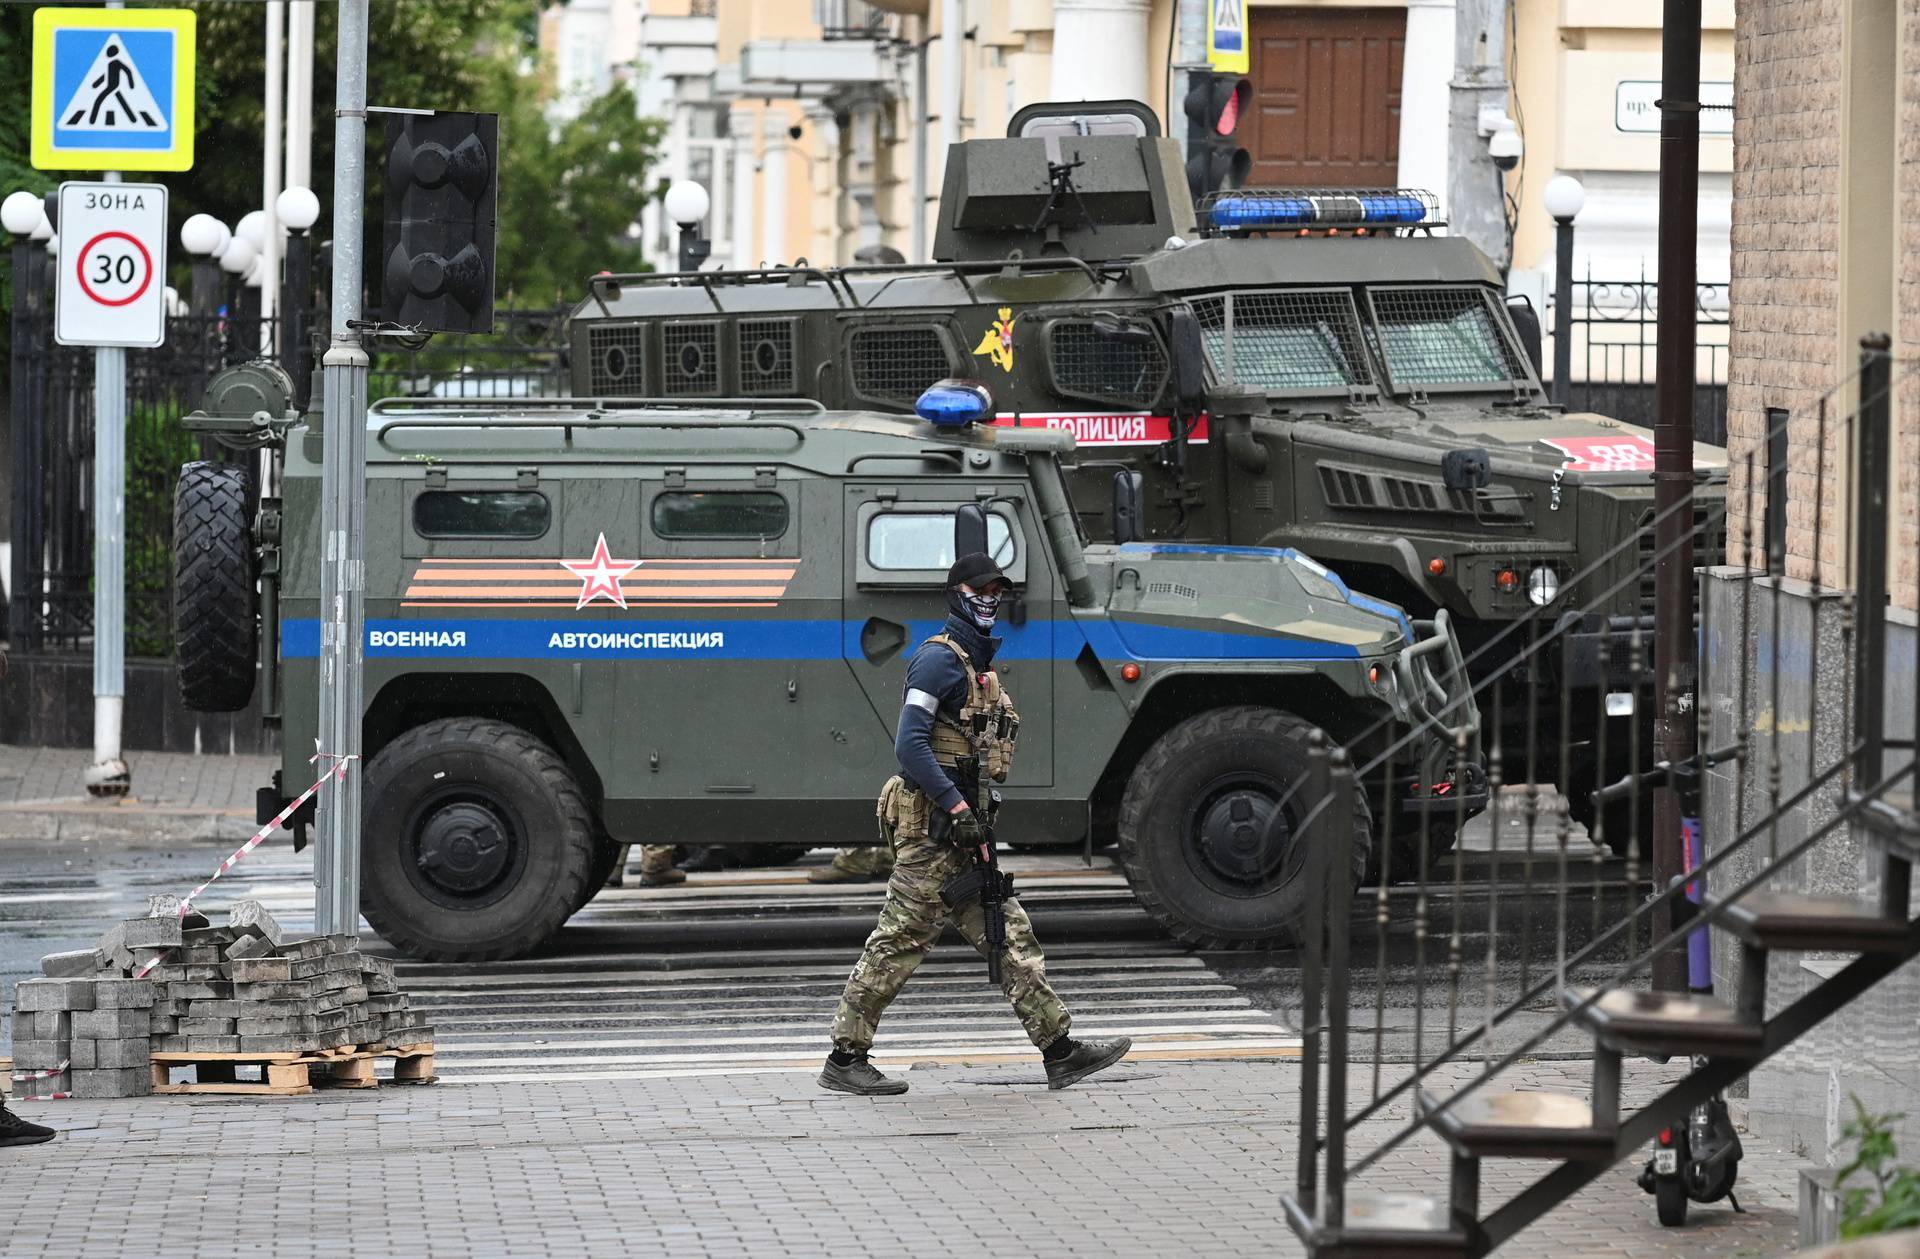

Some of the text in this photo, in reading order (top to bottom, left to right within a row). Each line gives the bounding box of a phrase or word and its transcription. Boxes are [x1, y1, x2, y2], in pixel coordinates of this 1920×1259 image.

[85, 193, 145, 210] ЗОНА
[93, 255, 135, 284] 30
[369, 631, 724, 649] ВОЕННАЯ АВТОИНСПЕКЦИЯ
